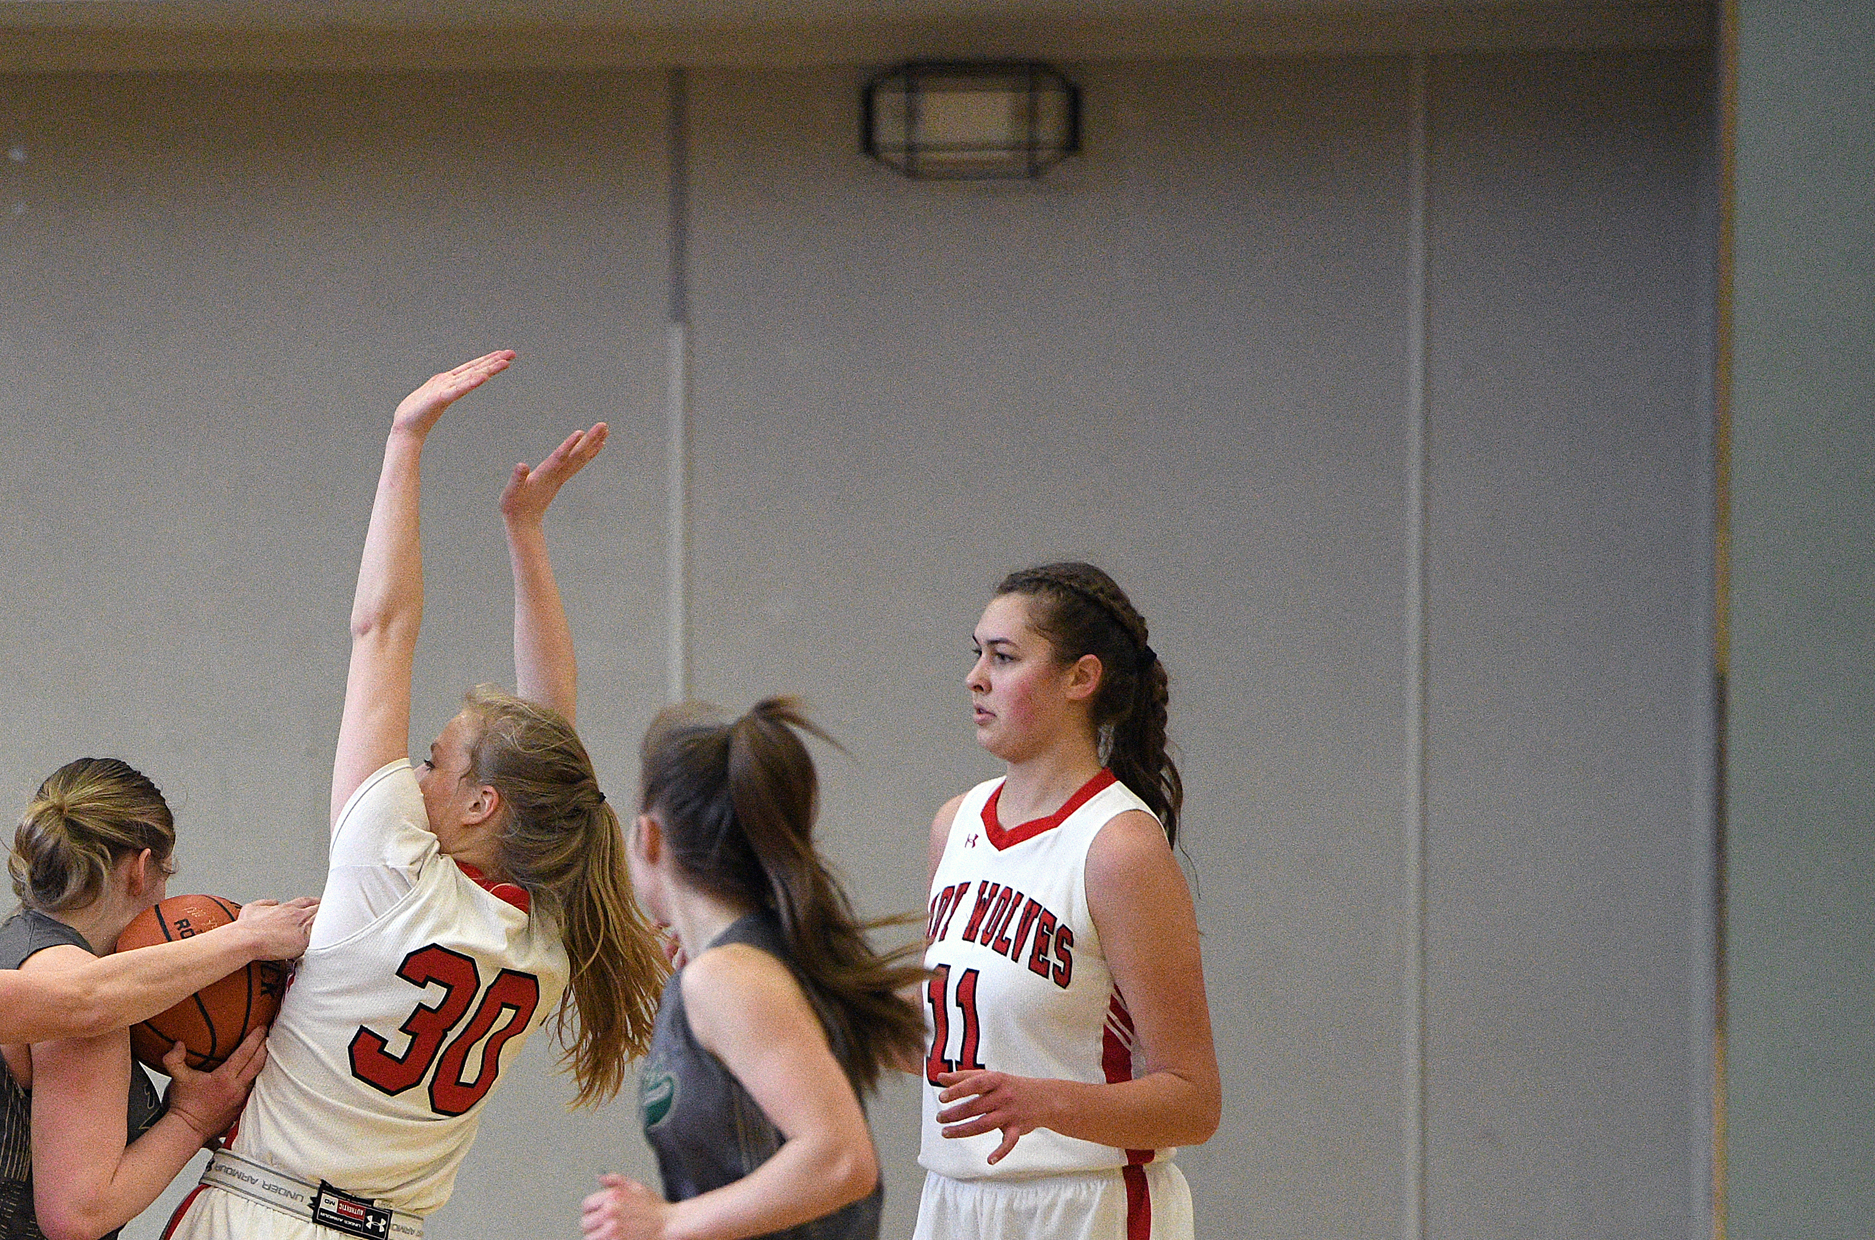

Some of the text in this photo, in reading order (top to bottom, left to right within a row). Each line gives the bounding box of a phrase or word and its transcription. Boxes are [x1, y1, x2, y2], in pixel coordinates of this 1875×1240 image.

[962, 880, 1075, 989] WOLVES
[348, 942, 540, 1117] 30
[926, 963, 986, 1088] 11
[215, 1162, 305, 1203] UNDER ARMOUR
